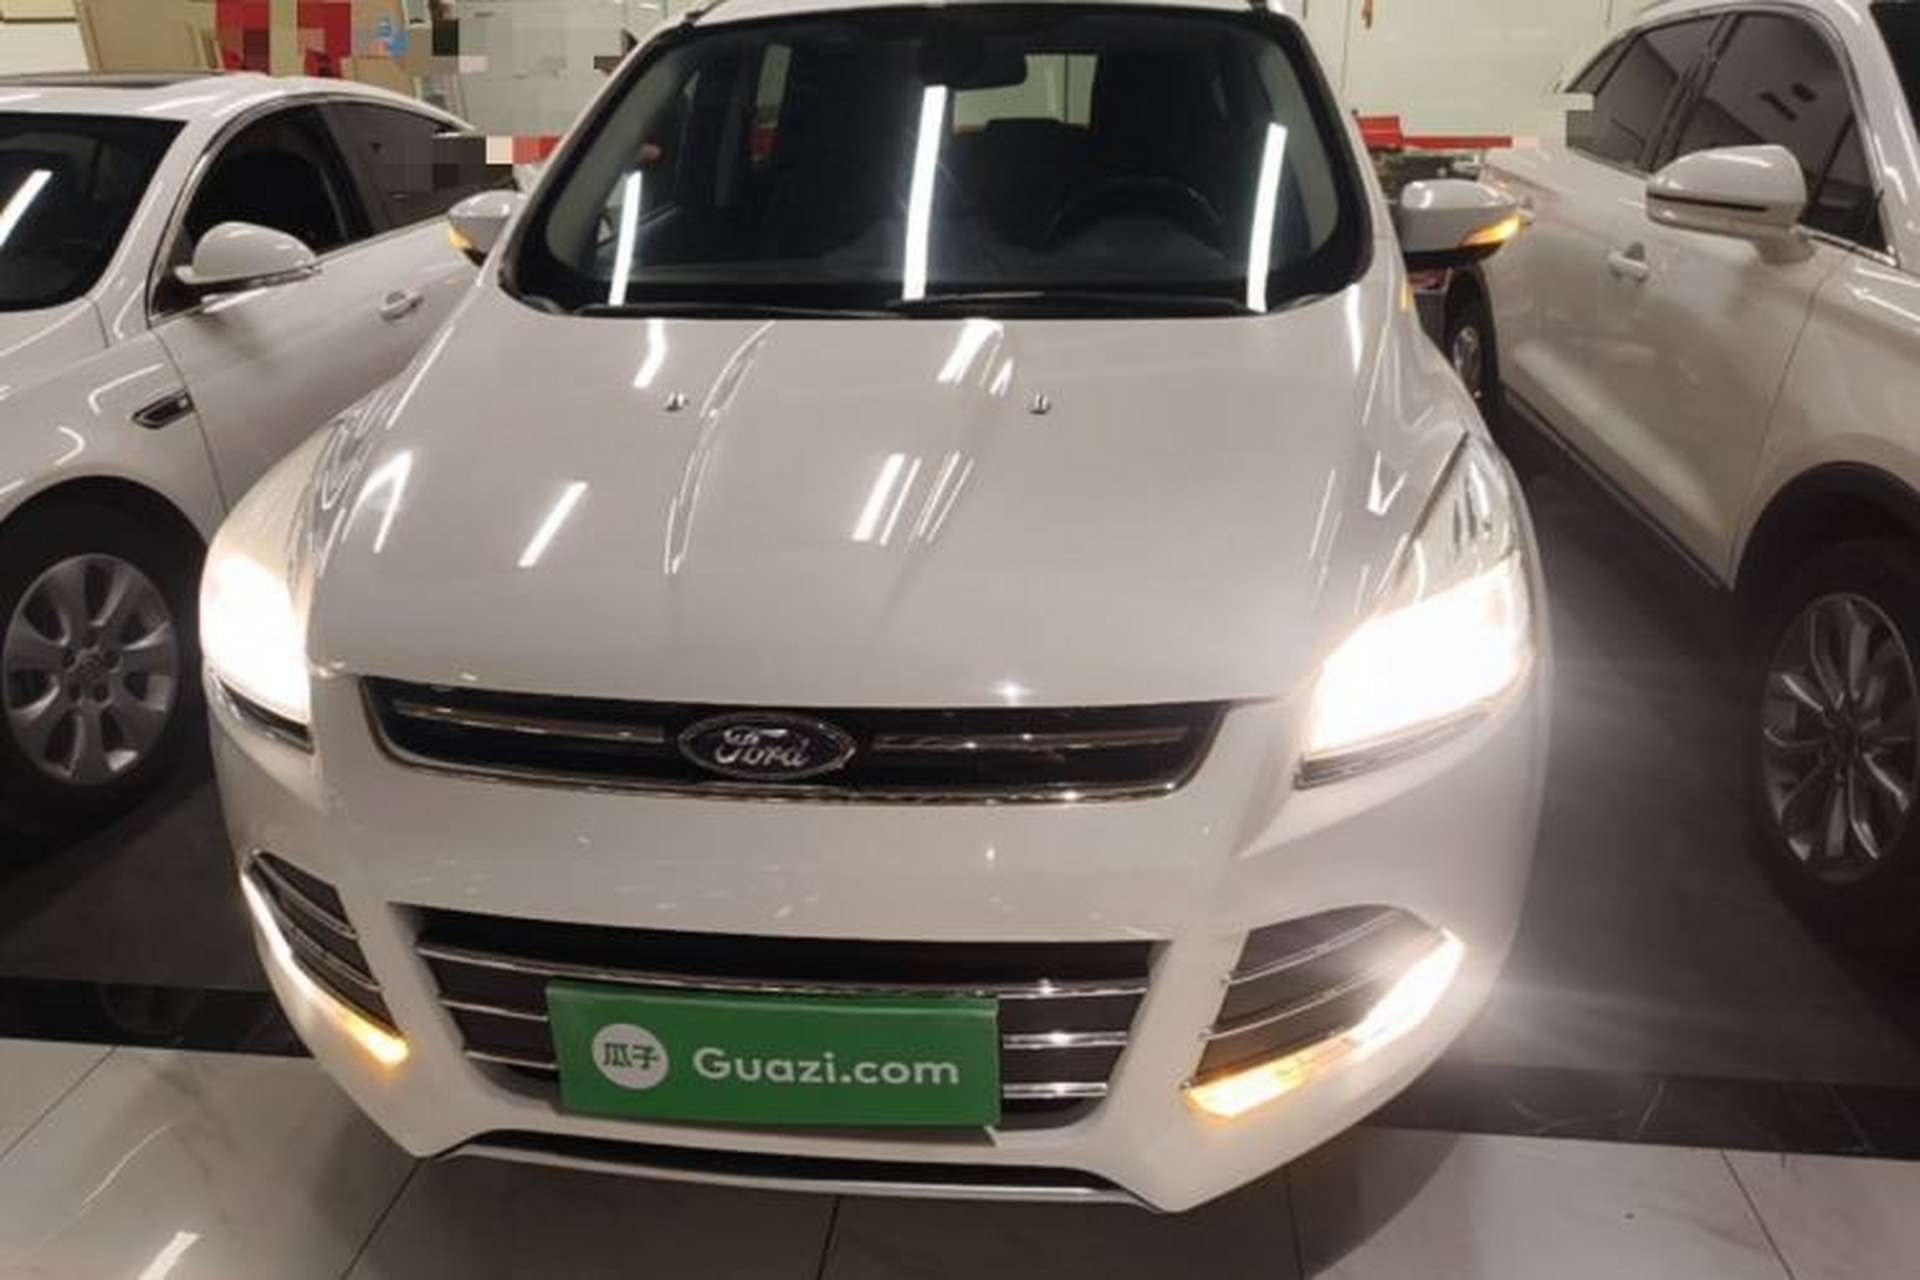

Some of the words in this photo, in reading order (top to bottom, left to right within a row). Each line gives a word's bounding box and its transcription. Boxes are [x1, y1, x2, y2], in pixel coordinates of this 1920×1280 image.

[715, 726, 810, 767] Ford
[602, 1042, 658, 1070] 瓜子
[692, 1046, 960, 1085] Guazi.com
